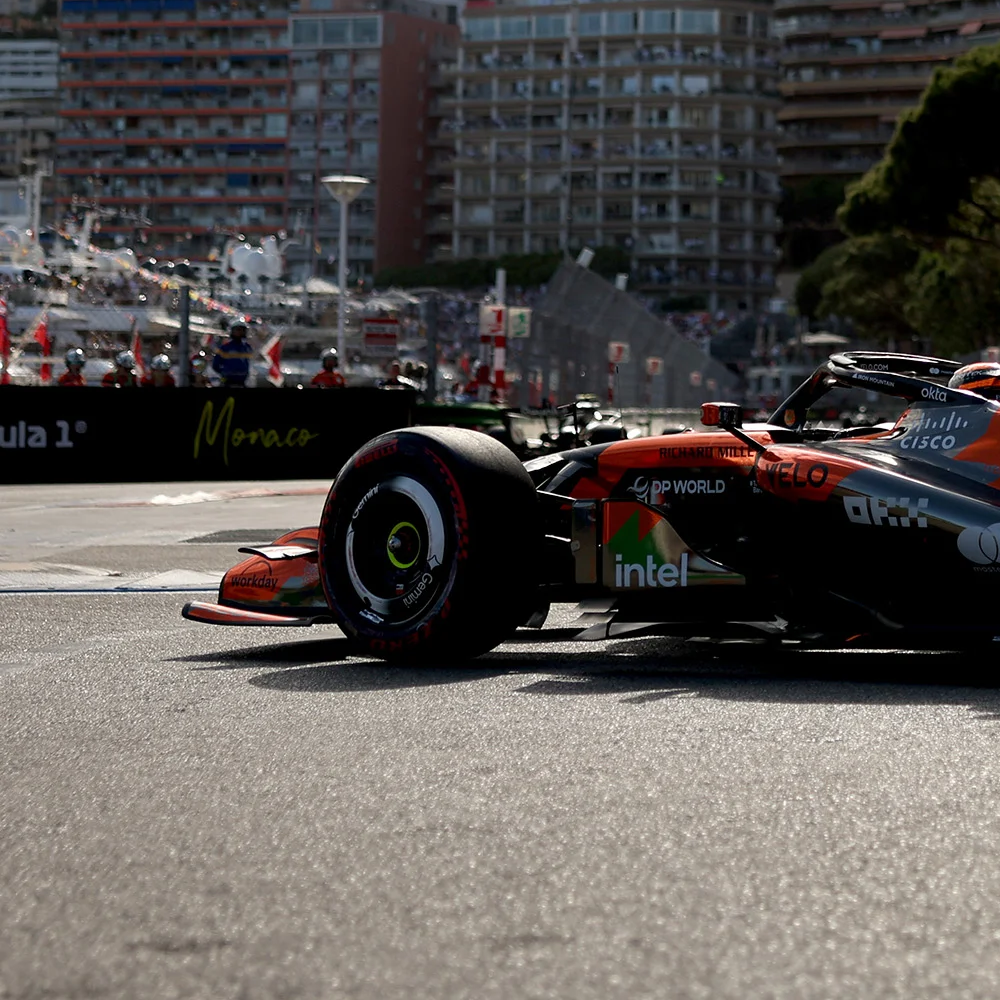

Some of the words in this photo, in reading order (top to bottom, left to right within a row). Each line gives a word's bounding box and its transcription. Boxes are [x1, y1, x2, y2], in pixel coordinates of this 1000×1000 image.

[921, 387, 947, 403] okta
[193, 396, 320, 467] Monaco
[659, 447, 713, 459] RICHARD
[719, 445, 754, 458] MILLE
[652, 480, 671, 494] DP
[673, 479, 726, 494] WORLD
[765, 463, 829, 489] VELO
[616, 552, 688, 588] intel
[231, 574, 278, 592] workday
[402, 572, 433, 609] Gemini
